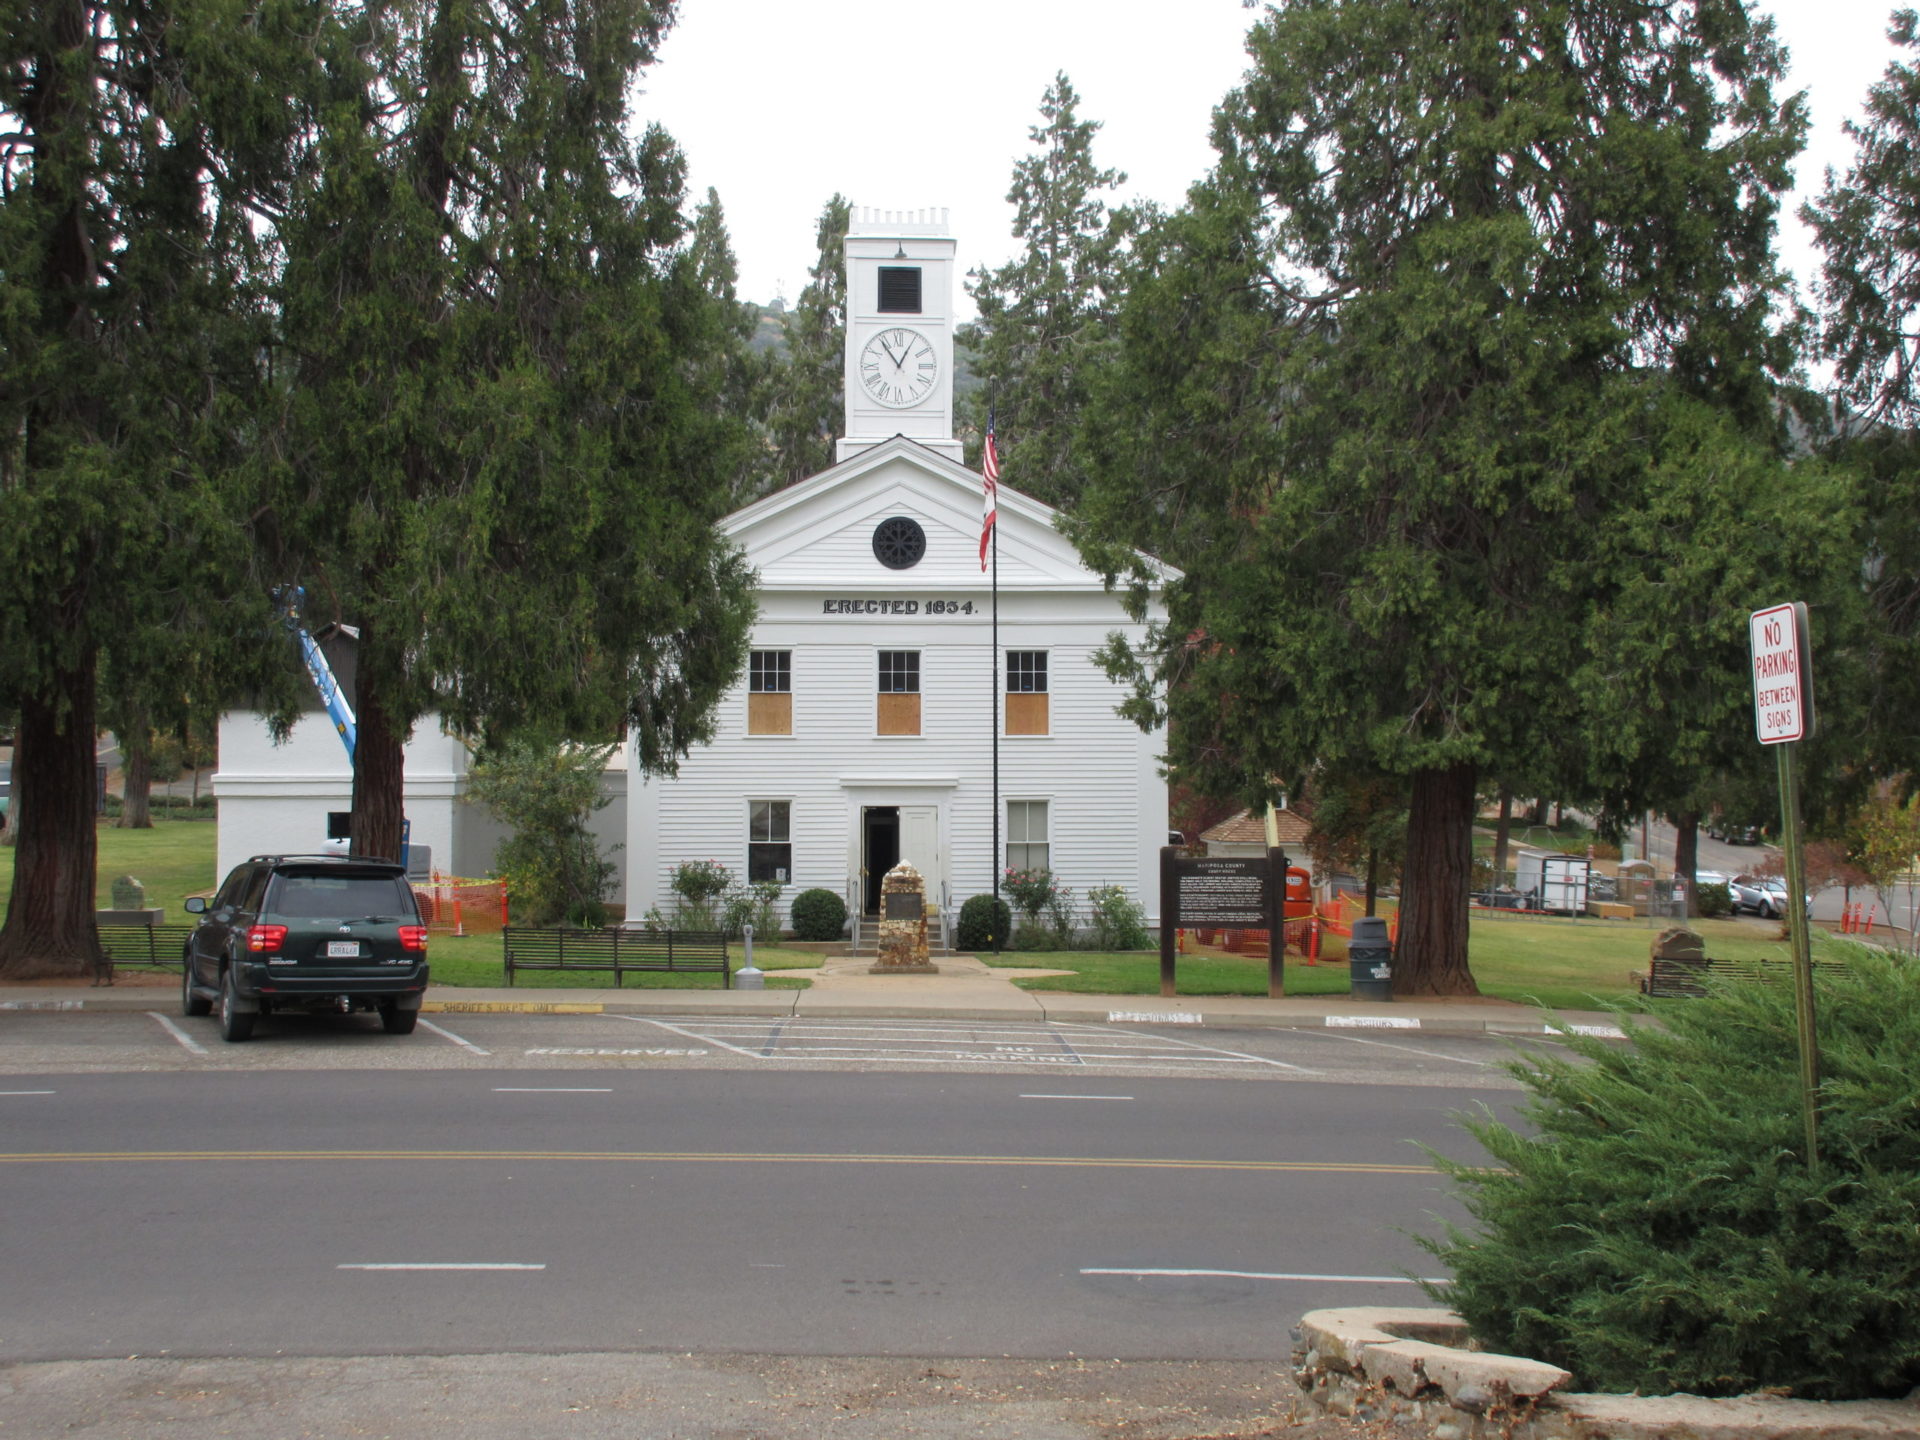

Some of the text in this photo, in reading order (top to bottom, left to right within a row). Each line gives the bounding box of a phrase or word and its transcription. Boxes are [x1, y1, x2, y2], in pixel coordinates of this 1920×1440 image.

[915, 347, 930, 358] II
[823, 599, 919, 615] ERECTED
[1764, 621, 1781, 648] NO
[1756, 649, 1795, 680] PARKING
[1759, 685, 1796, 707] BETWEEN
[1767, 709, 1792, 729] SIGNS
[525, 1048, 708, 1056] RESERVED
[955, 1054, 1080, 1062] PARKING
